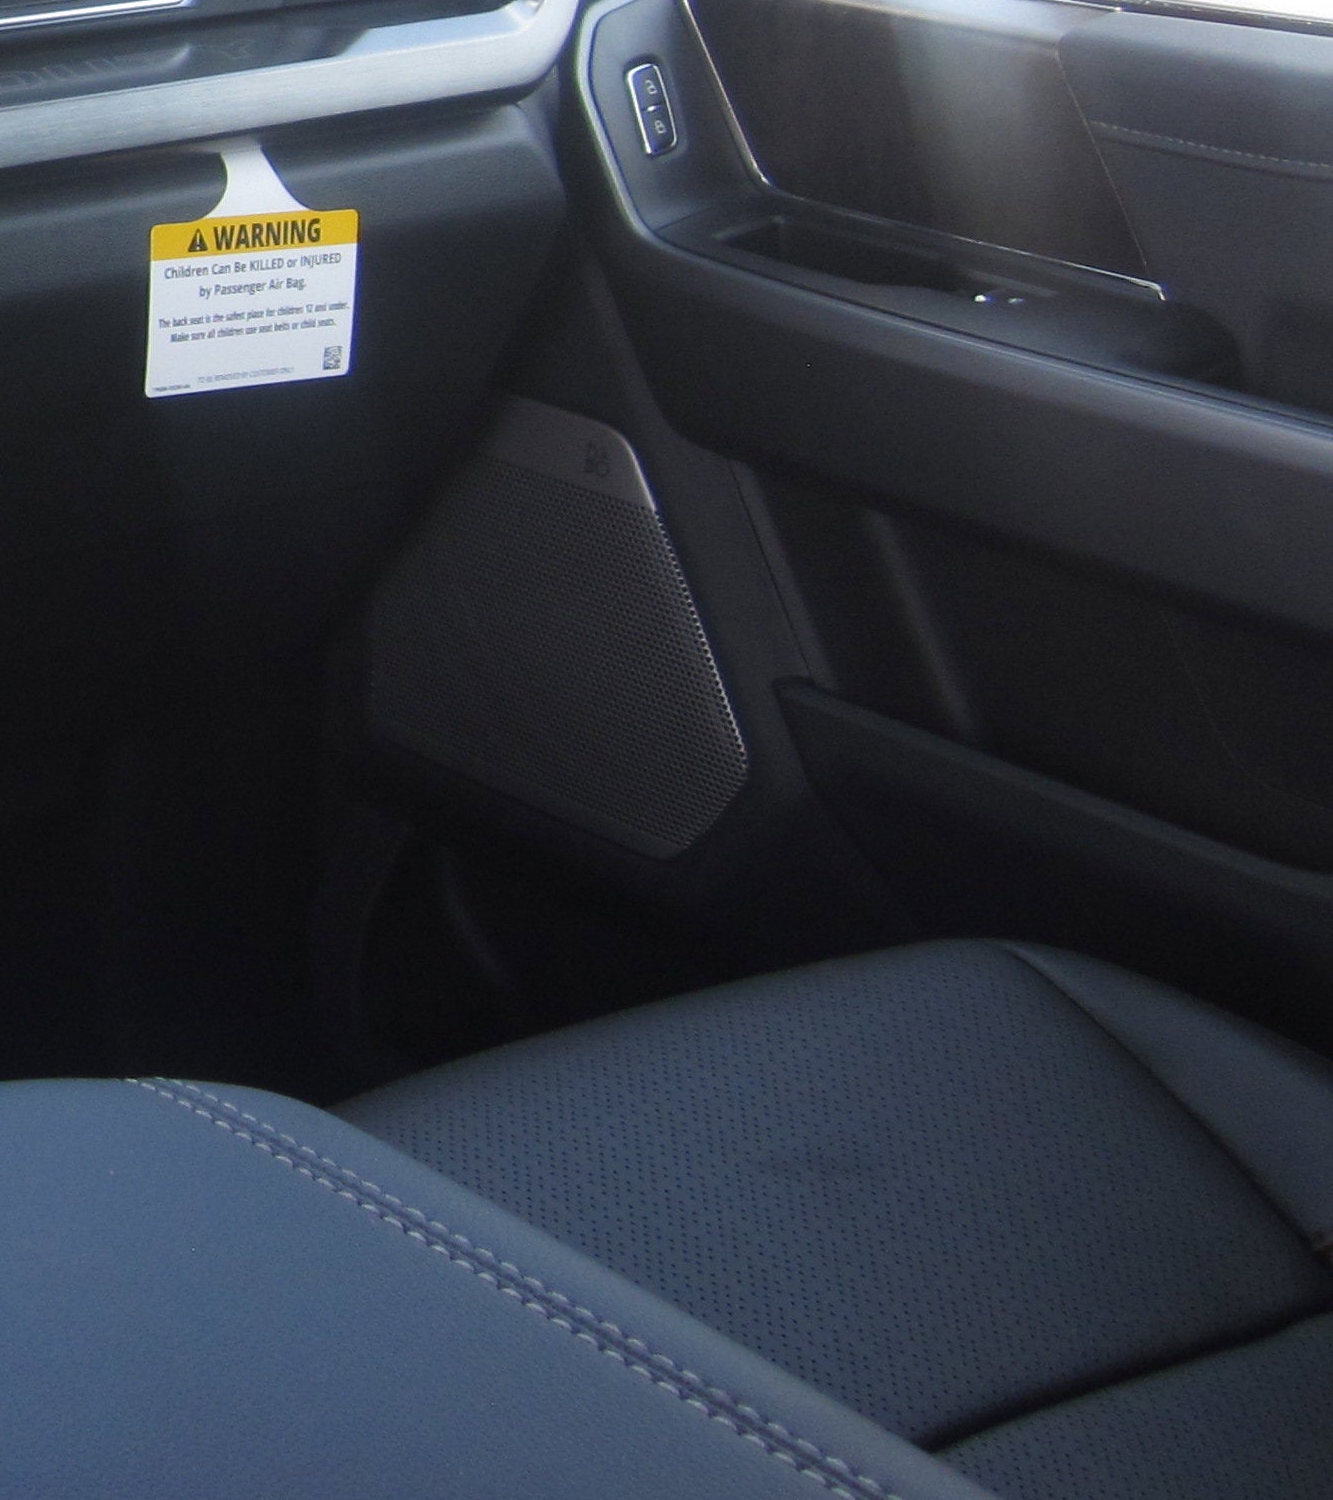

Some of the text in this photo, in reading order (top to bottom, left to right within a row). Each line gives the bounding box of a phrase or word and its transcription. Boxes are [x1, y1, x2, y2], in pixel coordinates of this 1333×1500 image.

[214, 218, 321, 251] WARNING
[164, 252, 342, 280] Children Can Be KILLED or INJURED
[199, 285, 211, 300] by
[214, 280, 266, 296] Passenger
[268, 278, 284, 290] Air
